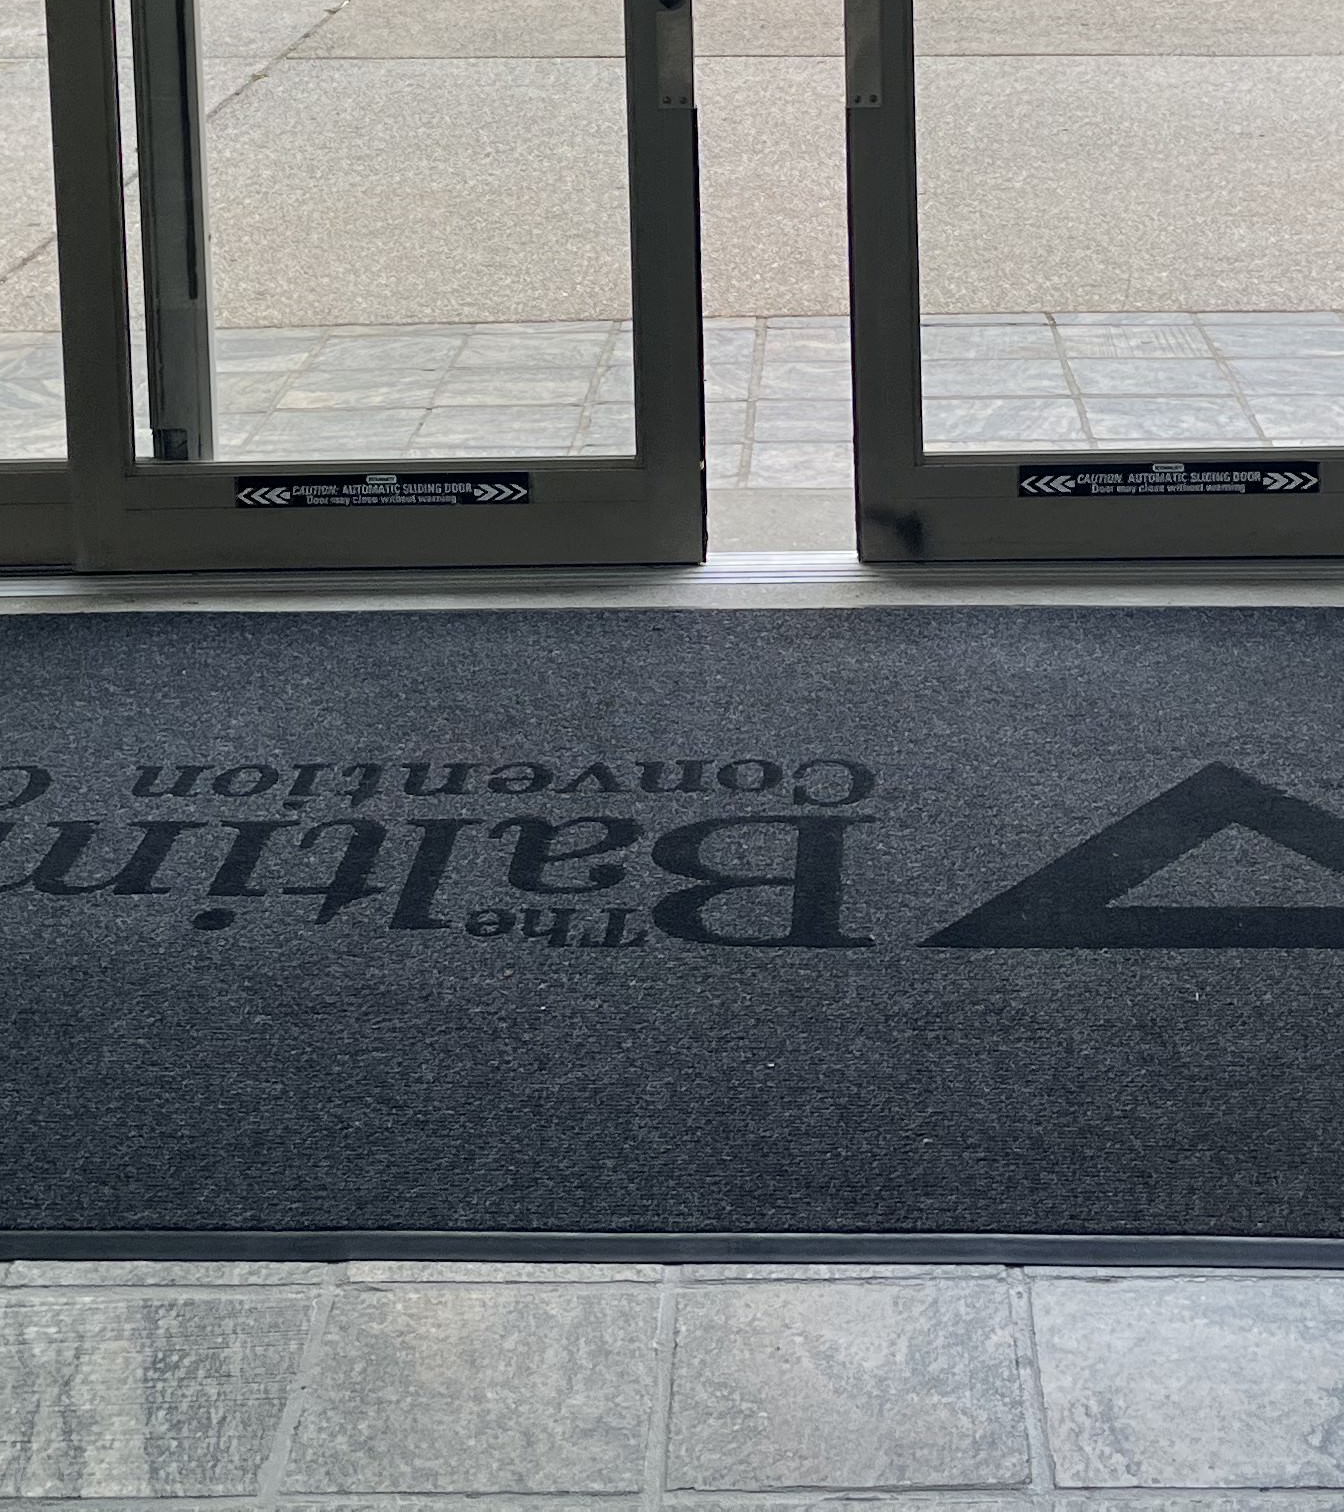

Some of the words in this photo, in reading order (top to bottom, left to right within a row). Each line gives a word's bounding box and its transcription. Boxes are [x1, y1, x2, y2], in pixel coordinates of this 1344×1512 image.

[342, 484, 401, 494] AUTOMATIC
[402, 483, 442, 494] SLIDING
[444, 482, 472, 493] DOOR
[1127, 472, 1187, 483] AUTOMATIC
[1190, 471, 1231, 483] SLIDING
[1233, 471, 1261, 482] DOOR
[131, 758, 876, 808] Convention
[465, 906, 651, 949] The
